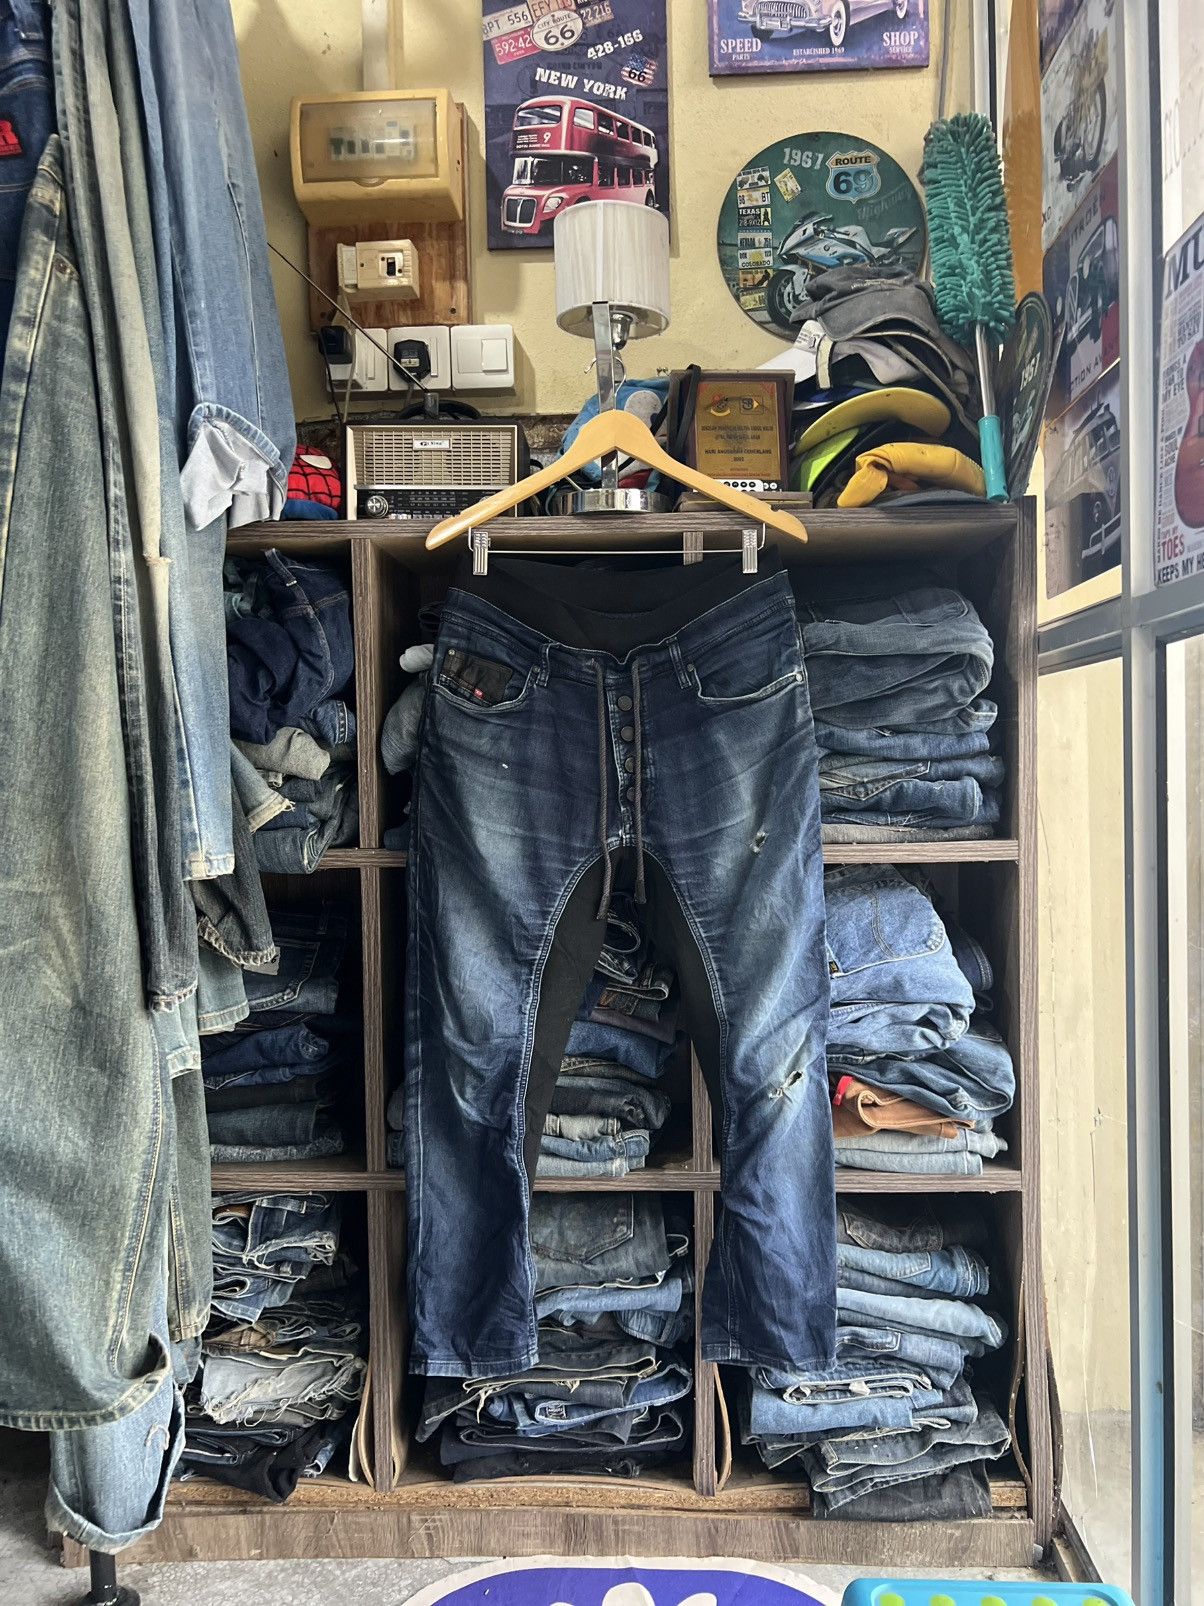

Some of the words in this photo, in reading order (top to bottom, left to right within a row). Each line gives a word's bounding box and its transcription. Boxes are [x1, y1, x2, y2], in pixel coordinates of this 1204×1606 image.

[508, 11, 528, 26] 556
[544, 24, 575, 46] 66
[587, 29, 643, 60] 428-166
[720, 38, 761, 54] SPEED
[883, 31, 919, 46] SHOP
[535, 67, 578, 89] NEW
[583, 78, 628, 100] YORK
[628, 68, 647, 83] 66
[543, 132, 551, 143] 9
[784, 148, 824, 169] 1967
[835, 156, 871, 165] ROUTE
[1161, 533, 1185, 563] TOES
[1157, 563, 1180, 585] KEEPS
[1182, 556, 1194, 577] MY
